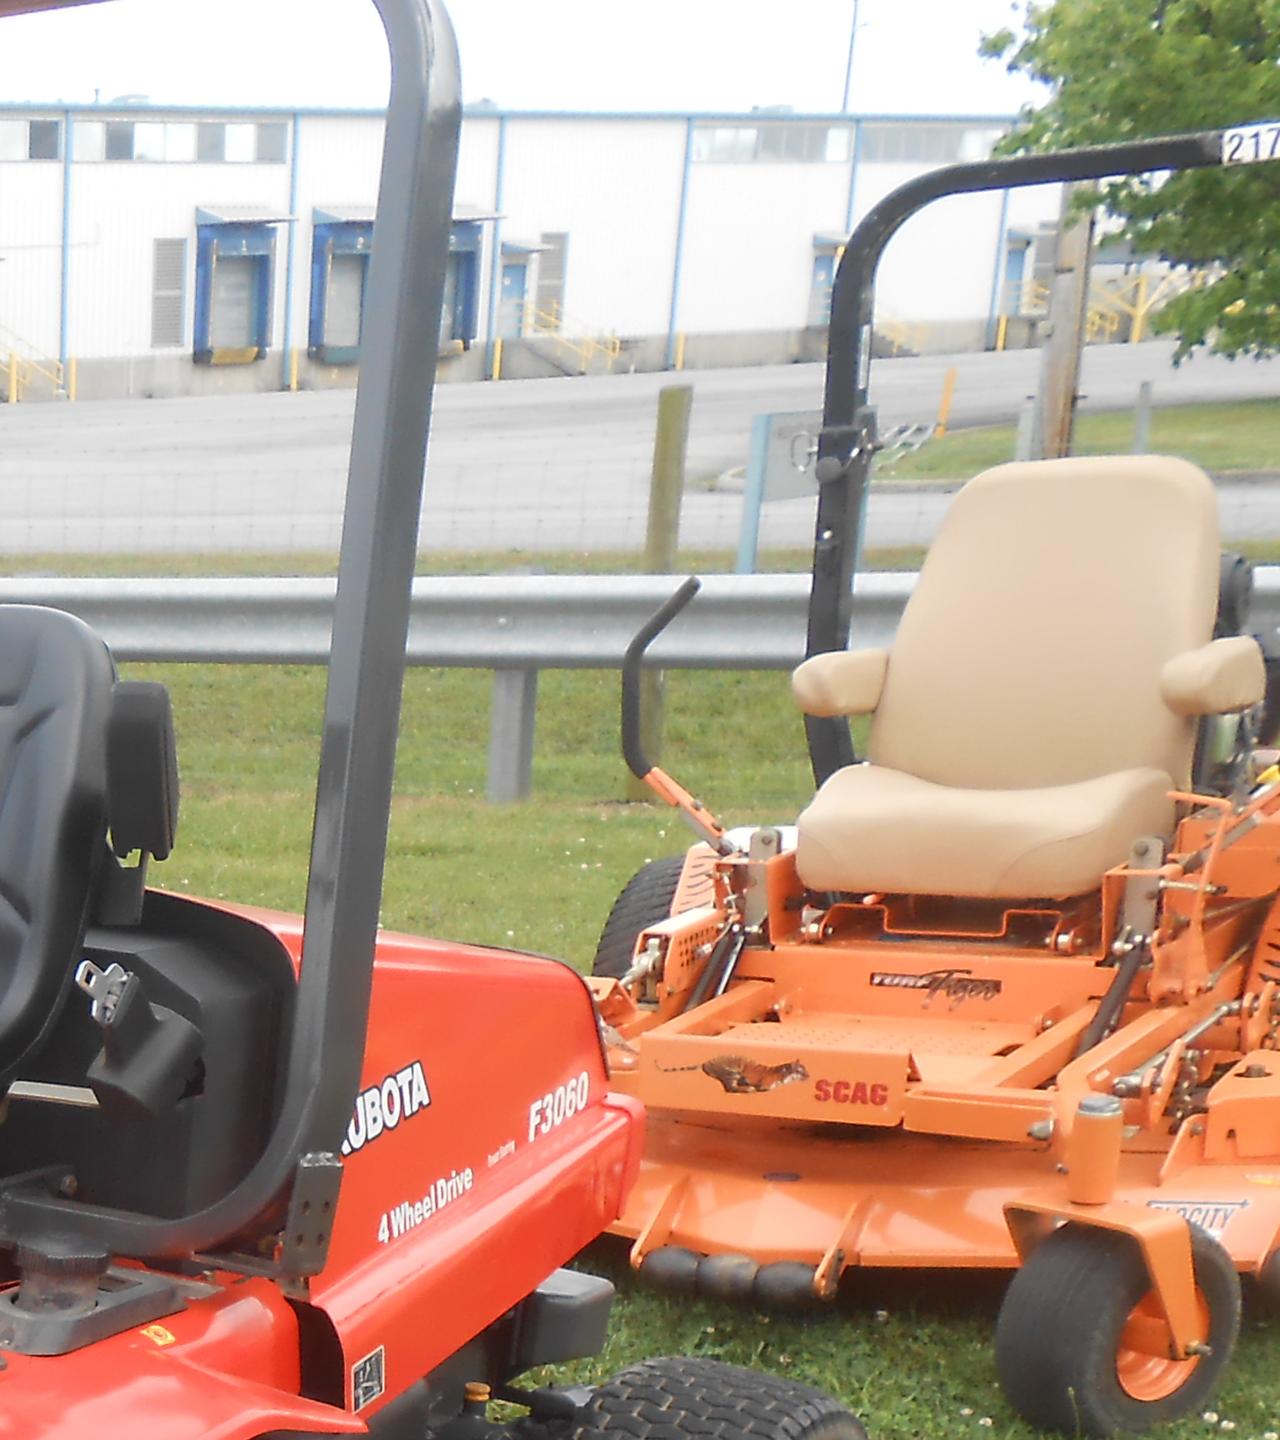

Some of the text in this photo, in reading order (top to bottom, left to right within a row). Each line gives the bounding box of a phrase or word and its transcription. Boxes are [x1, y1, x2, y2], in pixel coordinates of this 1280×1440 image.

[1227, 127, 1280, 163] 217
[342, 1060, 430, 1156] UBOTA
[528, 1071, 589, 1143] F3060
[814, 1079, 888, 1107] SCAG
[377, 1166, 474, 1243] 4 Wheel Drive
